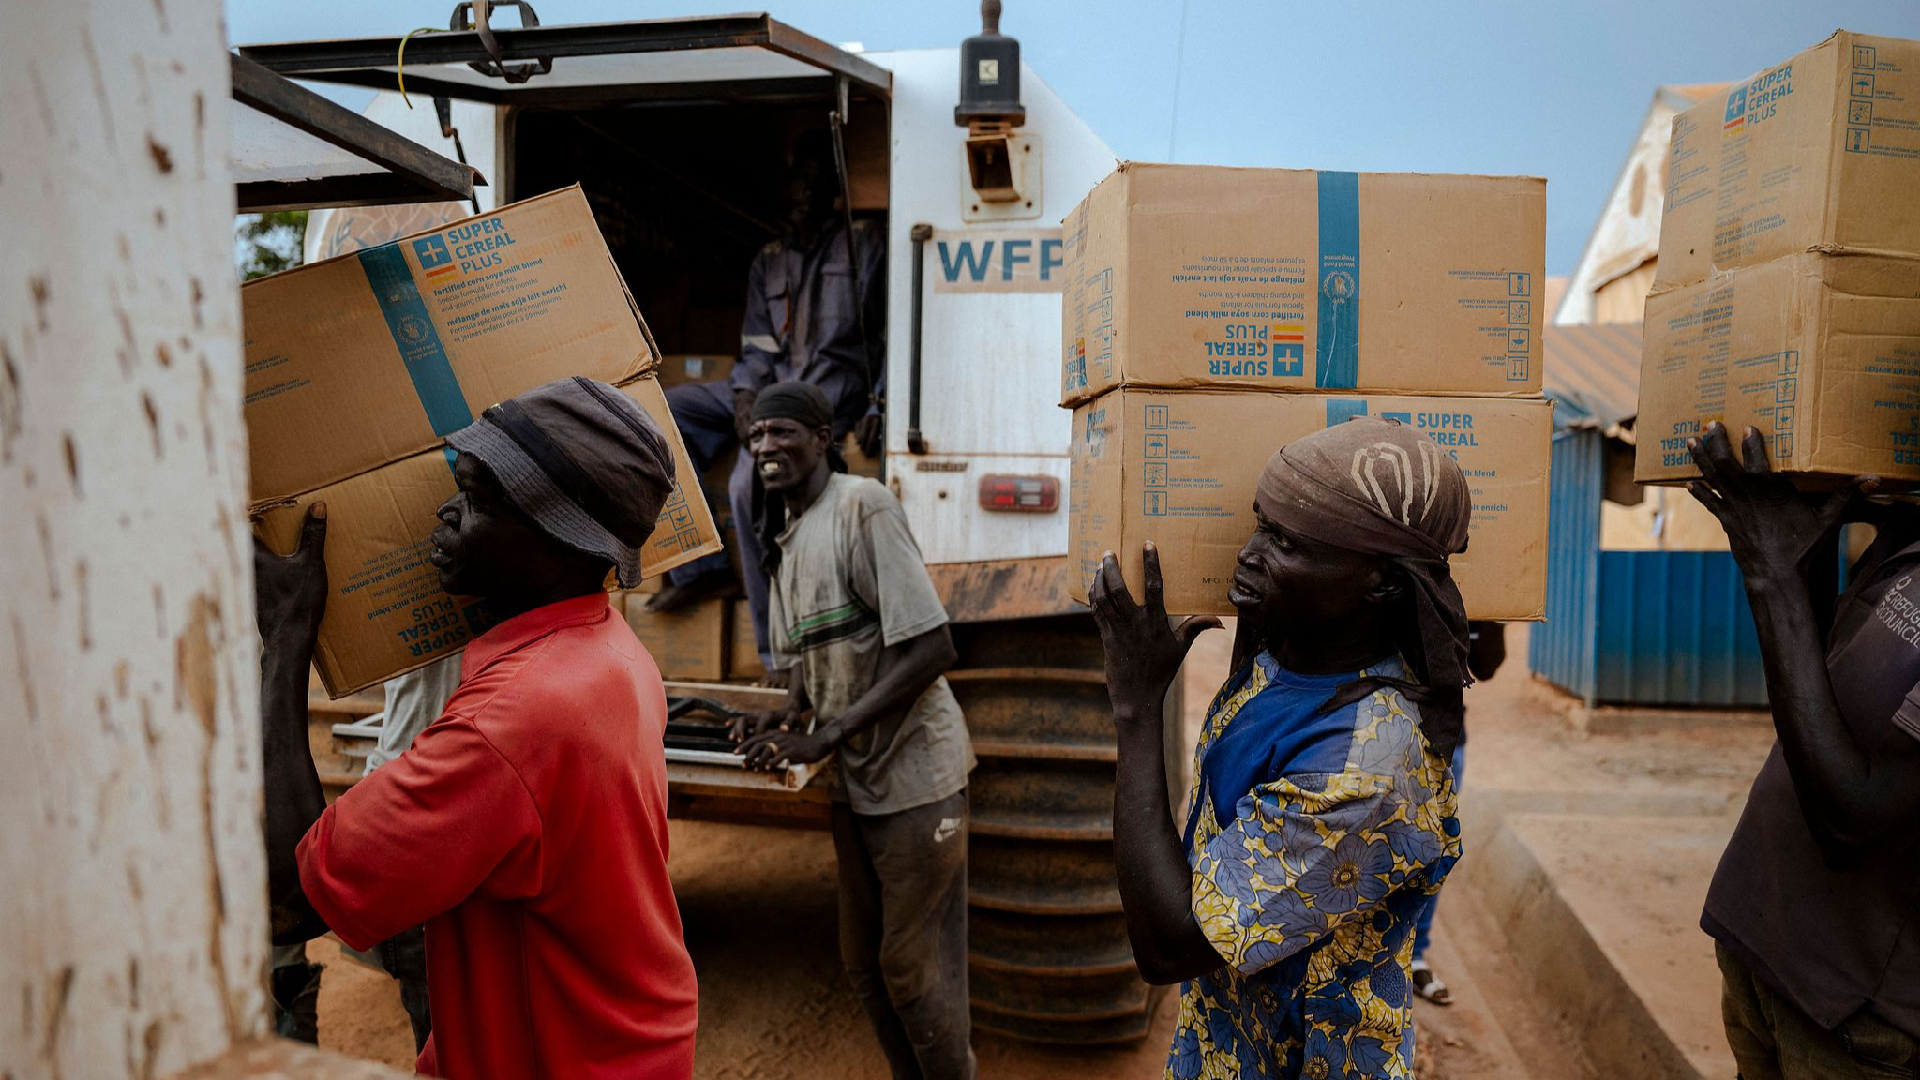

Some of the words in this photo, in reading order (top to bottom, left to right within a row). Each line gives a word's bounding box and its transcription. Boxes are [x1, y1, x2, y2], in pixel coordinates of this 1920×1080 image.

[1749, 67, 1792, 97] SUPER
[1748, 82, 1794, 112] CEREAL
[1747, 103, 1777, 125] PLUS
[447, 218, 505, 244] SUPER
[455, 232, 516, 259] CEREAL
[461, 253, 503, 274] PLUS
[937, 239, 1063, 282] WFP
[433, 282, 466, 296] fortified
[467, 277, 485, 286] corn
[485, 272, 504, 281] soya
[503, 265, 520, 275] milk
[520, 258, 543, 269] blend
[1219, 274, 1235, 282] soja
[1271, 276, 1305, 284] mélange
[1231, 309, 1250, 317] soya
[1271, 312, 1304, 320] fortified
[1225, 325, 1268, 338] PLUS
[1204, 342, 1268, 356] CEREAL
[1208, 360, 1268, 375] SUPER
[1417, 412, 1474, 429] SUPER
[1673, 421, 1700, 435] PLUS
[1427, 431, 1479, 446] REAL
[1889, 431, 1918, 446] EAL
[1662, 453, 1692, 466] UPER
[1893, 449, 1920, 465] PER
[1474, 469, 1496, 478] blend
[1481, 503, 1509, 512] enrichi
[1471, 514, 1500, 522] urrissons
[411, 598, 455, 621] PLUS
[397, 612, 461, 643] CEREAL
[1879, 606, 1920, 648] COUNCIL
[408, 628, 467, 657] SUPER
